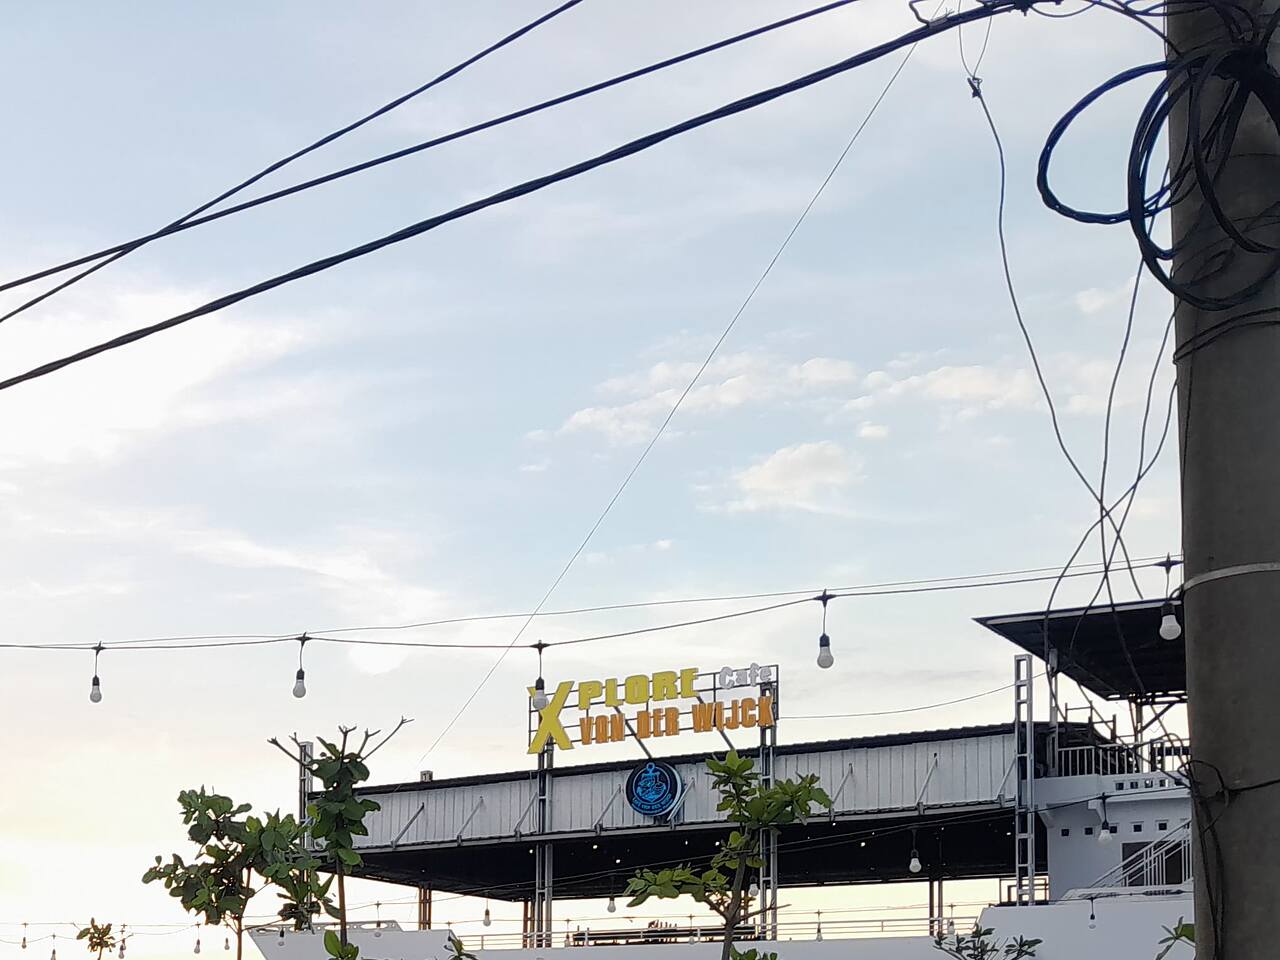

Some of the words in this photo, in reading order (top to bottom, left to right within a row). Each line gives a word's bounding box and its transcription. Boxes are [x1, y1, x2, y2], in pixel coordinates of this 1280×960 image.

[527, 667, 699, 754] XPLORE
[720, 662, 772, 690] Cafe
[636, 706, 680, 739] DER
[691, 695, 775, 733] WIJCK
